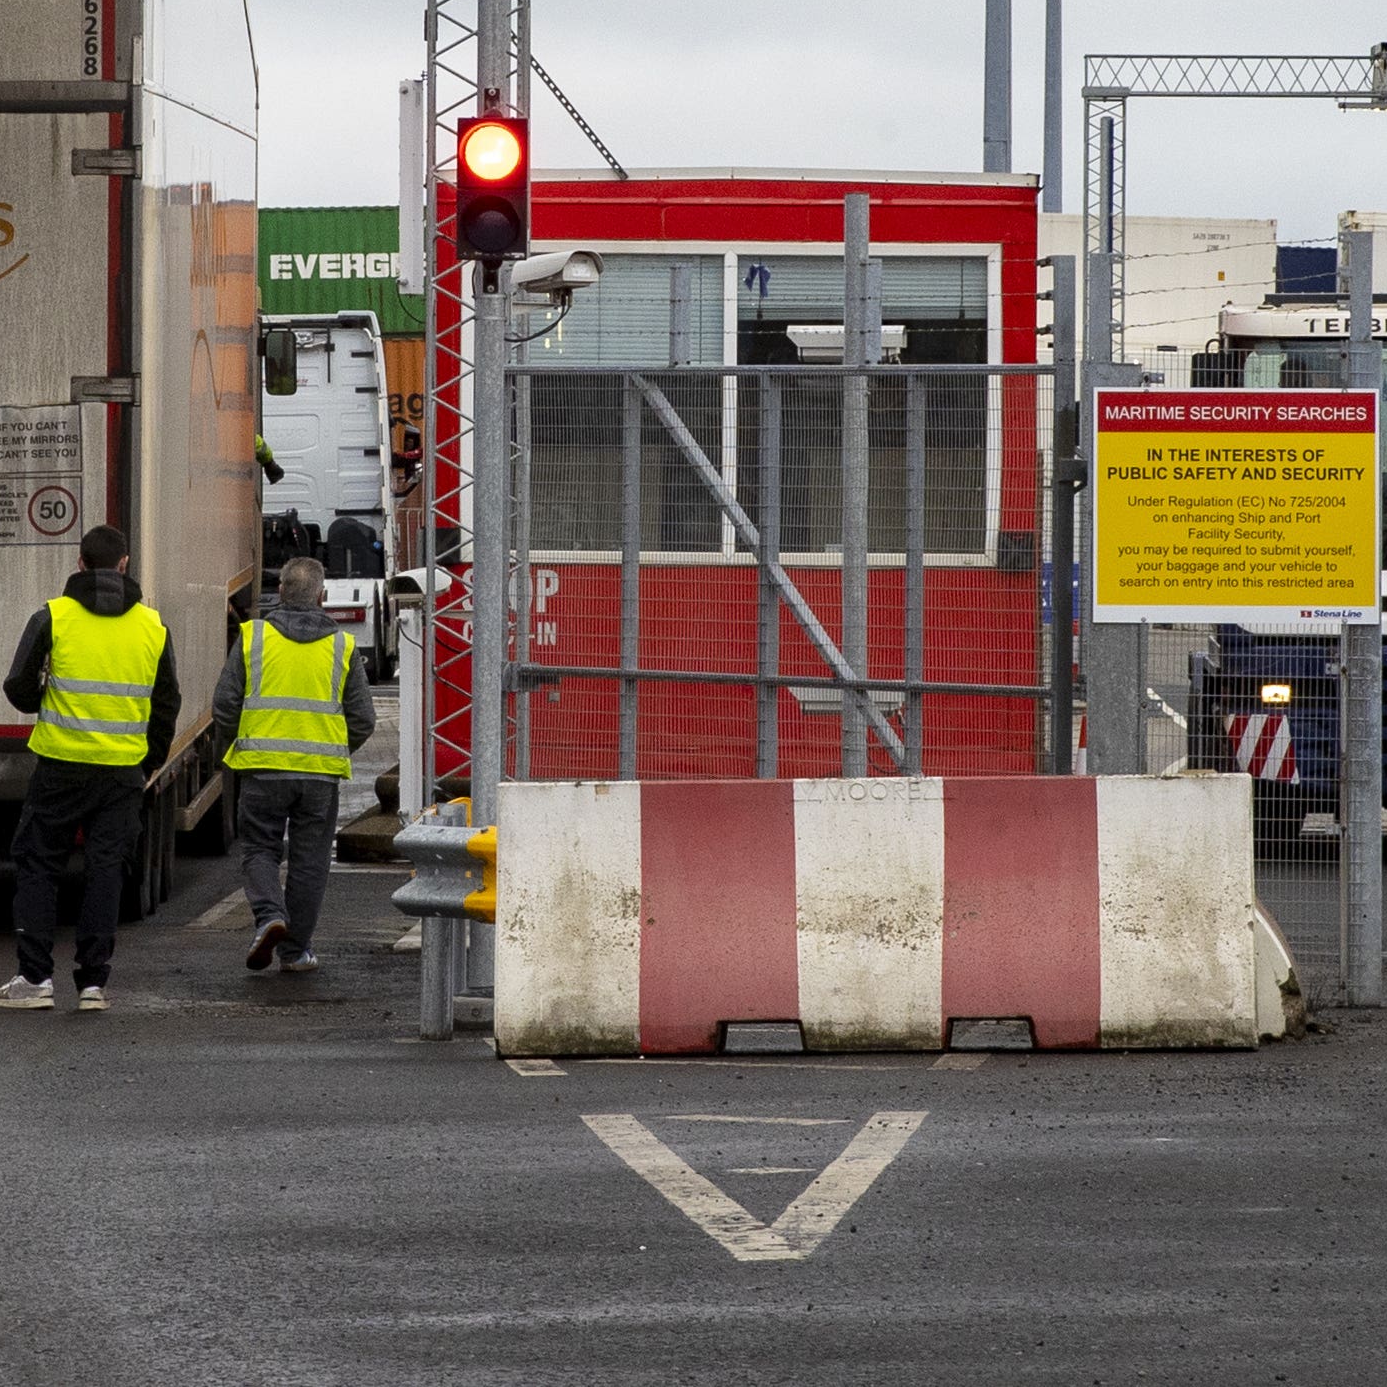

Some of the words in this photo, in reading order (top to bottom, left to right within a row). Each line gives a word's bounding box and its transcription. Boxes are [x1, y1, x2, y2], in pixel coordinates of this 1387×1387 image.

[1105, 406, 1185, 421] MARITIME
[1189, 406, 1273, 421] SECURITY
[1276, 406, 1367, 421] SEARCHES
[10, 422, 33, 432] YOU
[35, 421, 67, 431] CAN'T
[12, 436, 28, 446] MY
[30, 434, 79, 445] MIRRORS
[31, 449, 52, 459] SEE
[54, 448, 77, 458] YOU
[1146, 448, 1163, 462] IN
[1168, 448, 1200, 462] THE
[1205, 448, 1297, 462] INTERESTS
[1302, 448, 1325, 462] OF
[1107, 467, 1168, 481] PUBLIC
[1173, 467, 1238, 481] SAFETY
[1241, 467, 1276, 481] AND
[1281, 467, 1365, 481] SECURITY
[1127, 495, 1165, 507] Under
[1168, 495, 1233, 510] Regulation
[1236, 495, 1265, 510] (EC)
[1268, 496, 1286, 507] No
[1290, 496, 1346, 508] 725/2004
[39, 501, 67, 520] 50
[1152, 514, 1168, 524] on
[1172, 512, 1234, 527] enhancing
[1238, 512, 1266, 527] Ship
[1269, 512, 1291, 524] and
[1295, 512, 1321, 524] Port
[1188, 528, 1230, 543] Facility
[1233, 528, 1286, 543] Security,
[1118, 546, 1140, 559] you
[1143, 546, 1169, 559] may
[1172, 544, 1188, 556] be
[1191, 544, 1242, 559] required
[1245, 544, 1257, 556] to
[1260, 544, 1301, 556] submit
[1304, 544, 1356, 559] yourself,
[1136, 562, 1163, 575] your
[1166, 560, 1219, 575] baggage
[1223, 560, 1246, 572] and
[1249, 562, 1276, 575] your
[1279, 560, 1322, 572] vehicle
[1325, 561, 1337, 572] to
[1119, 576, 1161, 588] search
[1164, 578, 1179, 588] on
[1183, 577, 1213, 591] entry
[1216, 576, 1239, 588] into
[1242, 576, 1264, 588] this
[1267, 576, 1323, 588] restricted
[1326, 578, 1355, 588] area
[1313, 609, 1340, 619] Stena
[1341, 609, 1363, 619] Line
